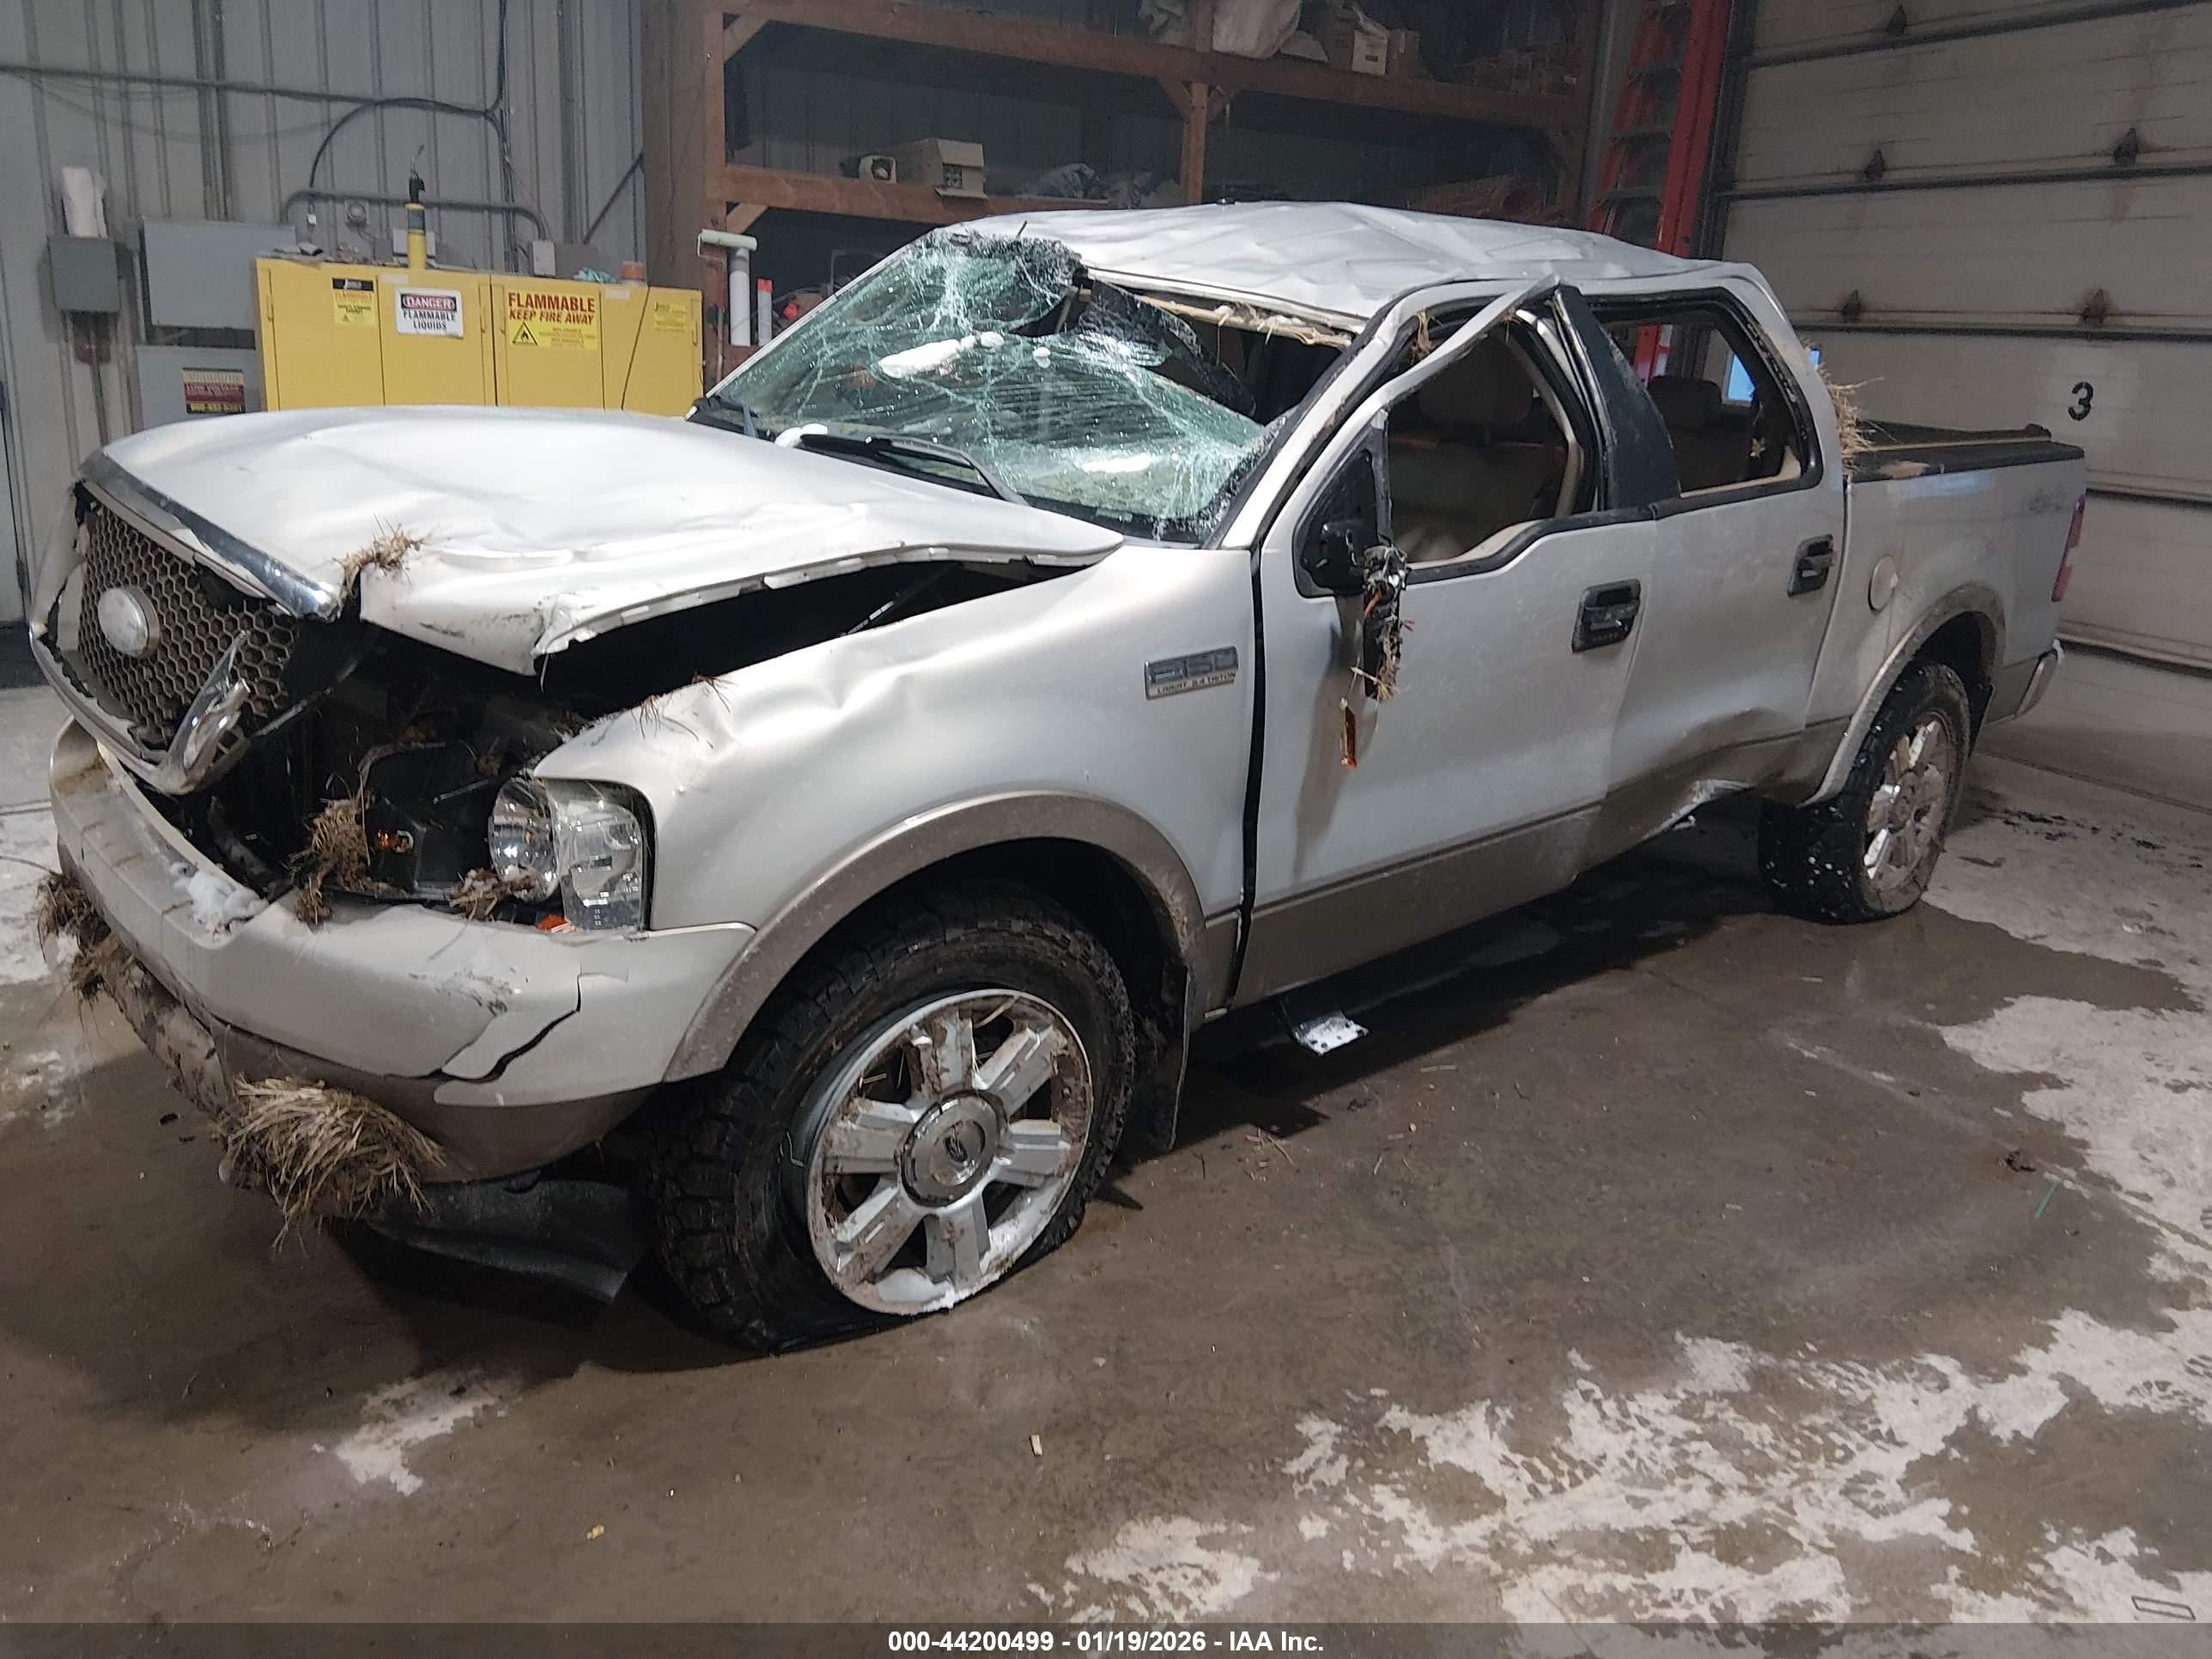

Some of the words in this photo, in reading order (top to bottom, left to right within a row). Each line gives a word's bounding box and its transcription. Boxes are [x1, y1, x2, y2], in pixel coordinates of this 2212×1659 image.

[407, 295, 453, 310] DANGER
[507, 292, 595, 313] FLAMMABLE
[404, 309, 456, 322] FLAMMABLE
[509, 308, 537, 321] KEEP
[539, 311, 562, 323] FIRE
[565, 313, 594, 325] AWAY
[413, 320, 447, 331] LIQUIDS
[2068, 381, 2094, 421] 3
